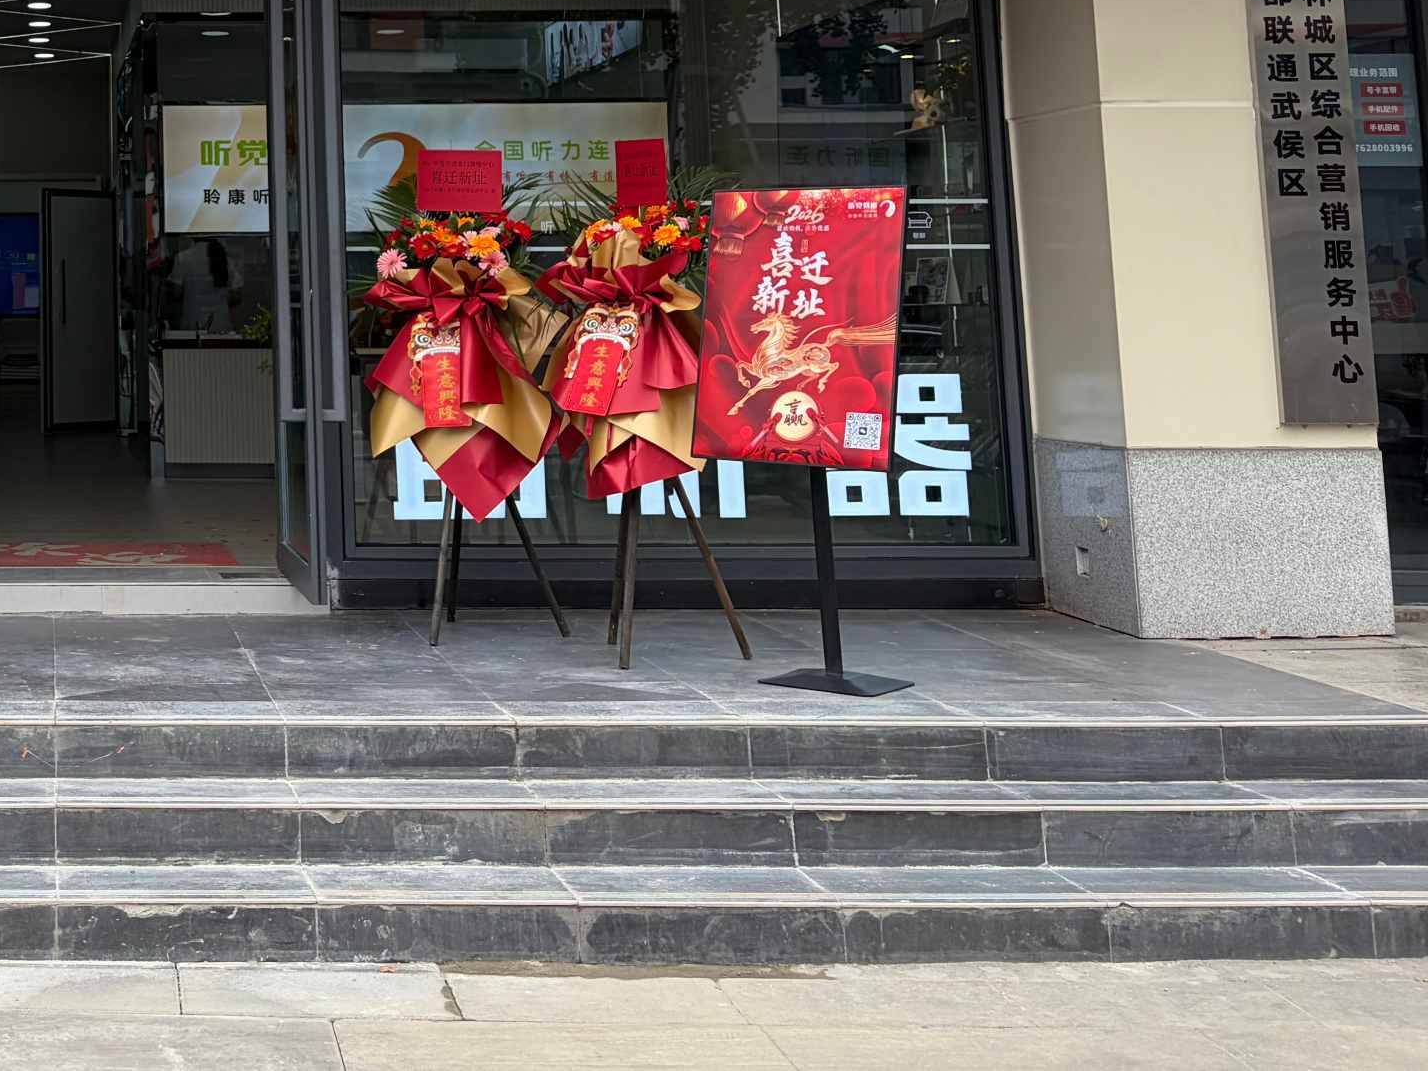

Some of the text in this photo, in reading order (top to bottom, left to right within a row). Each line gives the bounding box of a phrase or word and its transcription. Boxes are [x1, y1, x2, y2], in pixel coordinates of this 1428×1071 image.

[784, 205, 825, 224] 2026
[761, 231, 833, 285] 喜迁
[750, 275, 826, 319] 新址
